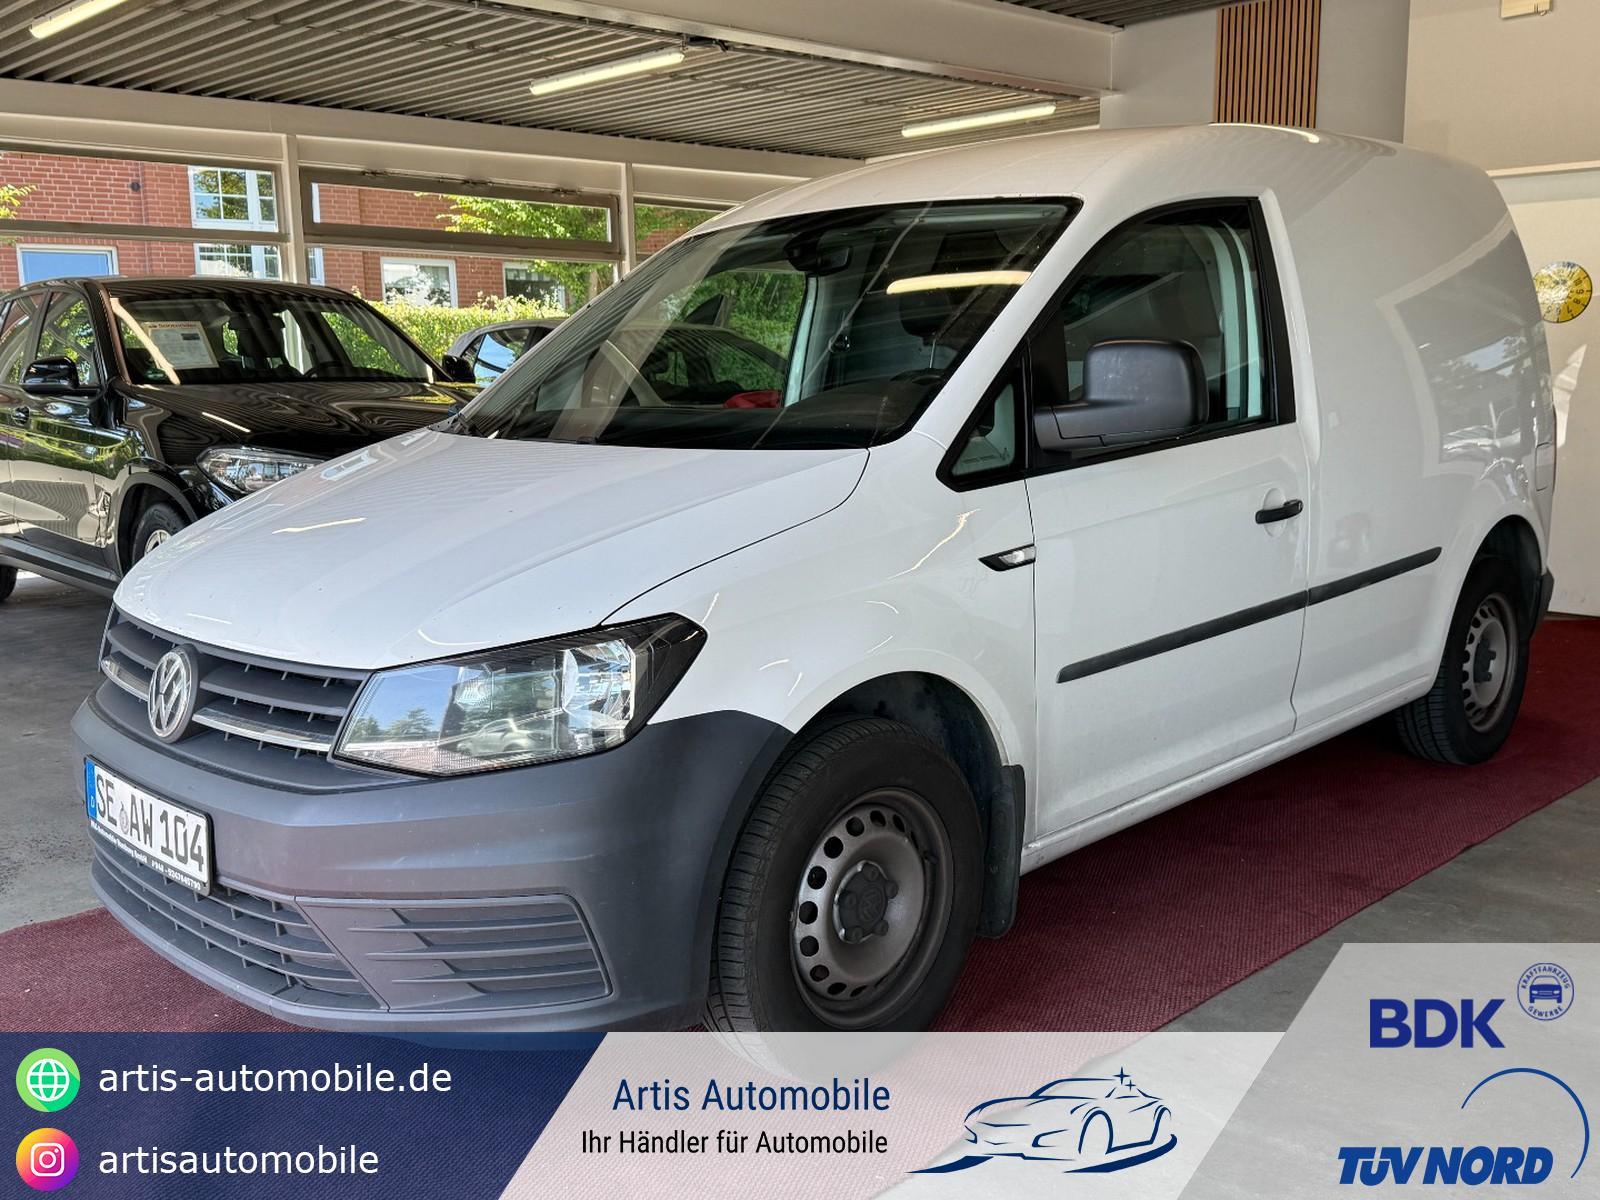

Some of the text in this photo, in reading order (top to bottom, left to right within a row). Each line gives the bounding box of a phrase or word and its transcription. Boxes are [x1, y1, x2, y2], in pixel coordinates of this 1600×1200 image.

[96, 773, 118, 827] SE
[130, 793, 153, 849] AW
[159, 809, 204, 872] 104
